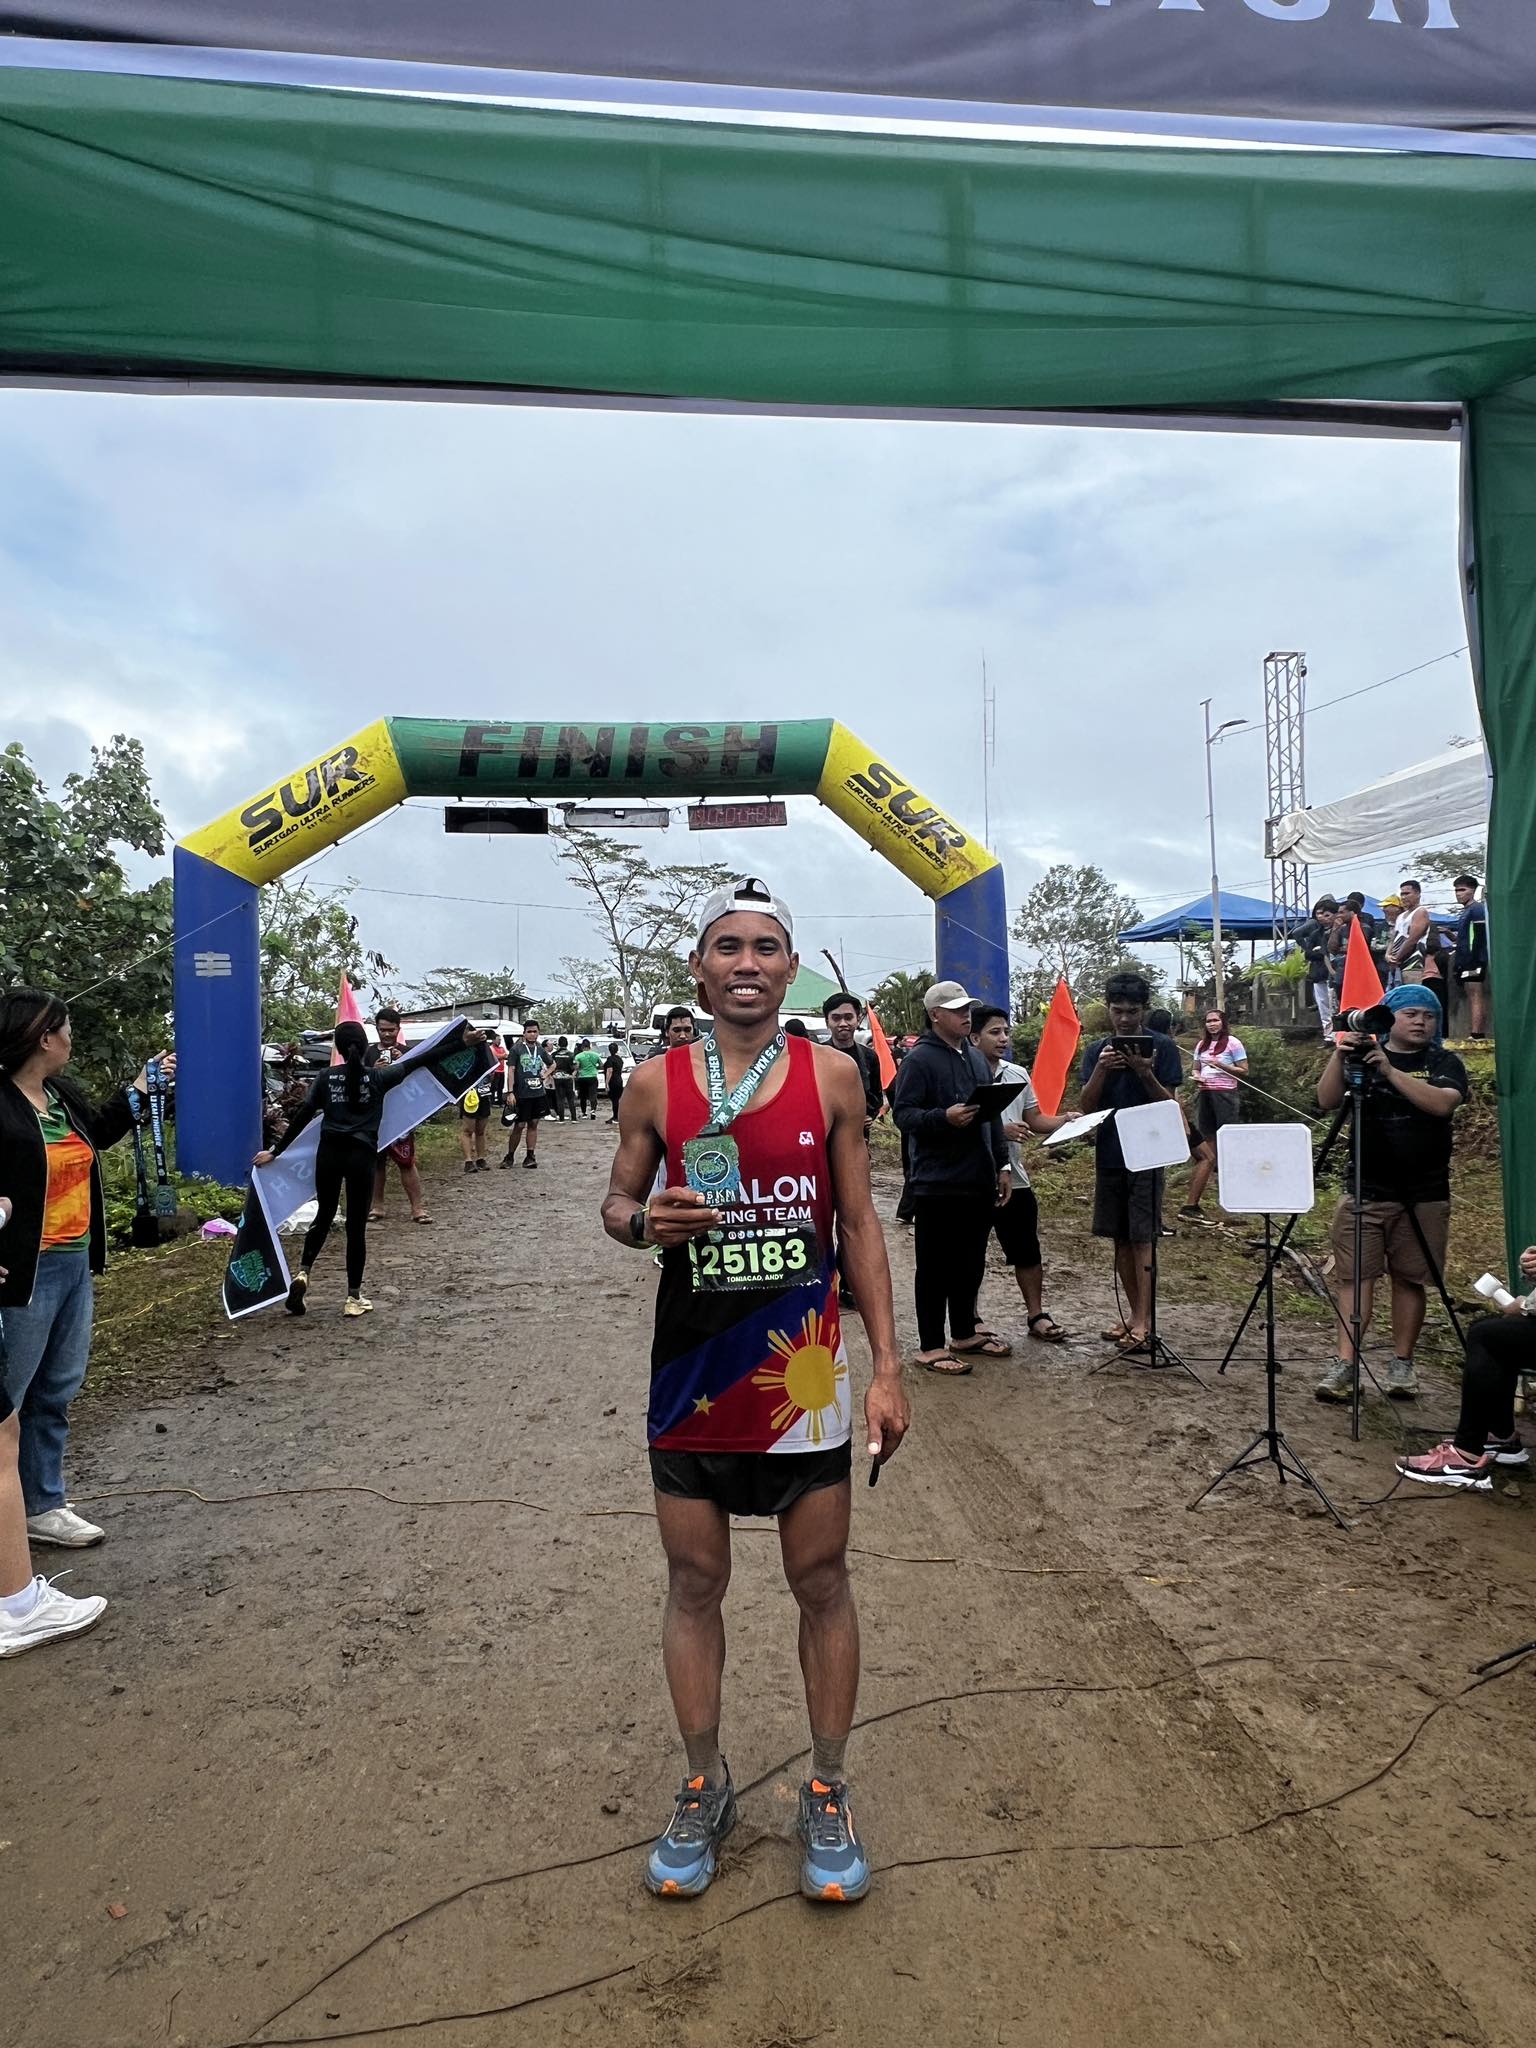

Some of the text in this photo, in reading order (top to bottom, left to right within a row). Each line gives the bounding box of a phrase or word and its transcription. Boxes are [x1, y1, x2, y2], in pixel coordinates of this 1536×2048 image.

[458, 725, 778, 778] FINISH
[240, 746, 368, 848] SUR
[253, 823, 299, 856] SURIGAO
[300, 804, 330, 826] ULTRA
[332, 775, 376, 808] RUNNERS
[844, 779, 883, 813] SURIGAO
[883, 812, 908, 836] ULTRA
[907, 834, 948, 869] RUNNERS
[850, 763, 966, 859] SUR
[709, 1055, 723, 1100] FINISHER
[728, 1044, 778, 1114] 25 KM FINISHER
[762, 1206, 812, 1221] TEAM
[701, 1238, 807, 1275] 25183
[765, 1273, 784, 1281] ANDY
